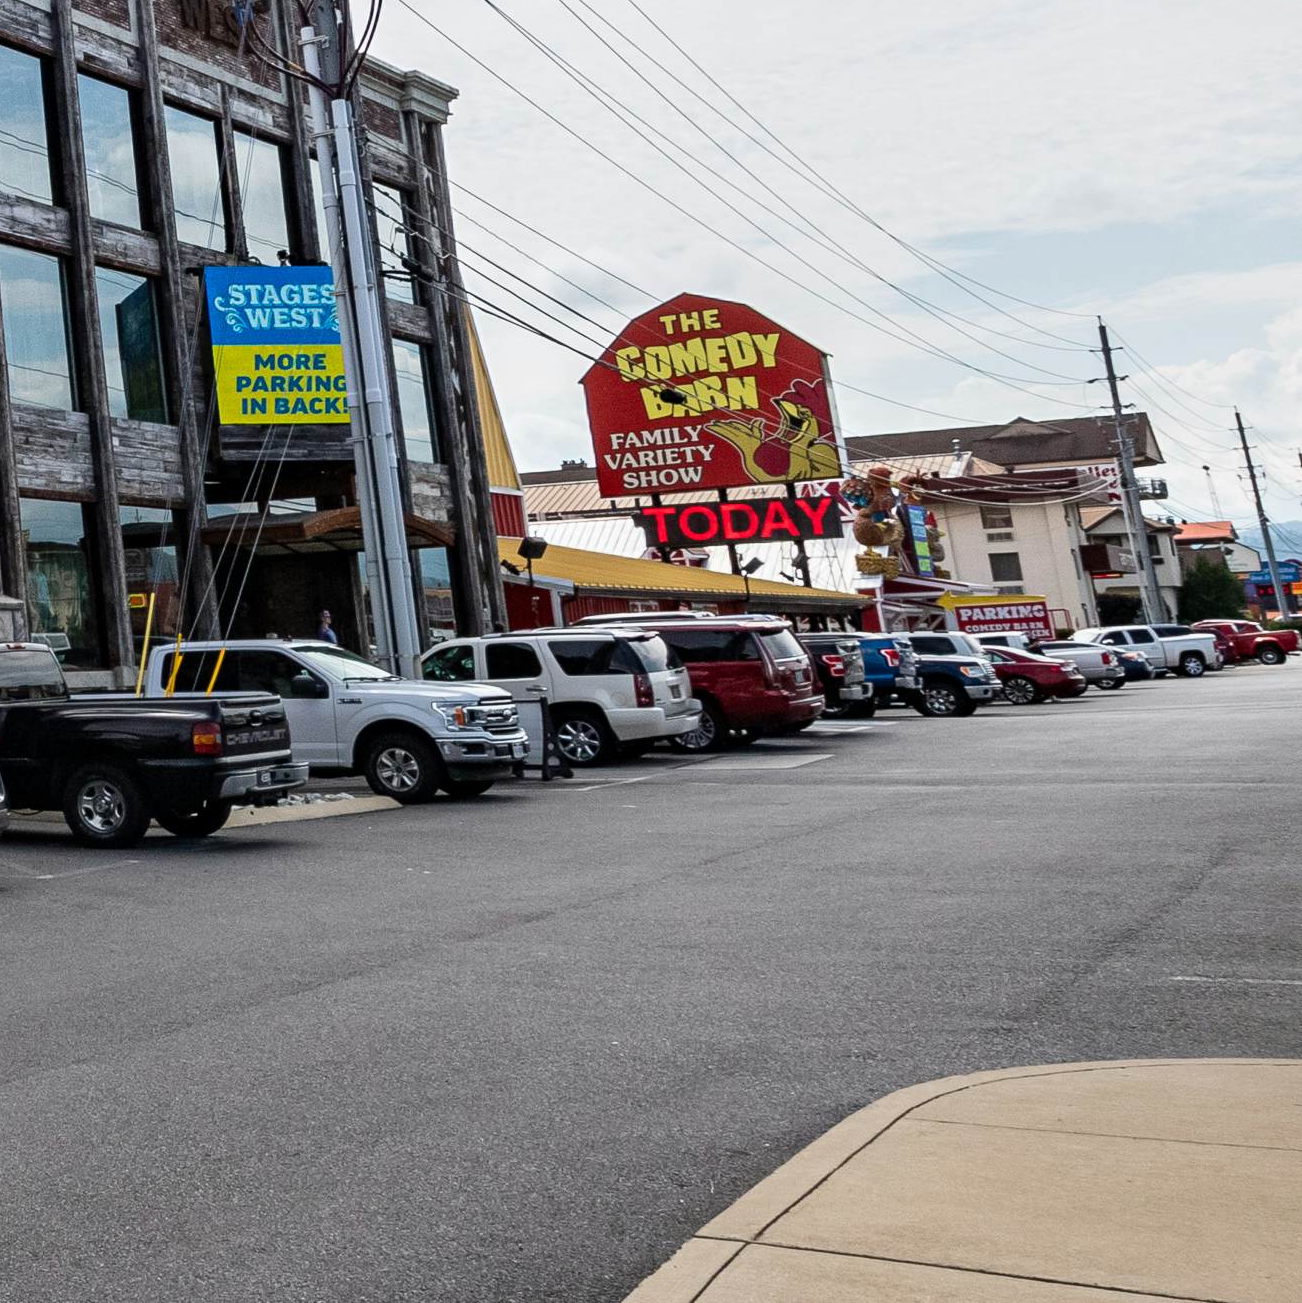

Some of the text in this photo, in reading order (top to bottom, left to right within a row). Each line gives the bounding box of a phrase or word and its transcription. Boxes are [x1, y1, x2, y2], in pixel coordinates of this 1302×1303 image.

[228, 284, 336, 306] STAGES
[245, 307, 323, 330] WEST
[659, 309, 722, 335] THE
[254, 353, 327, 371] MORE
[615, 331, 780, 382] COMEDY
[236, 375, 347, 392] PARKING
[241, 397, 348, 415] IN BACK!
[640, 376, 759, 420] BARN
[610, 424, 705, 450] FAMILY
[603, 444, 715, 470] VARIETY
[622, 466, 703, 489] SHOW
[642, 497, 832, 544] TODAY
[959, 604, 1045, 621] PARKING
[965, 623, 1011, 632] COMEDY
[226, 728, 287, 746] CHEVROLET
